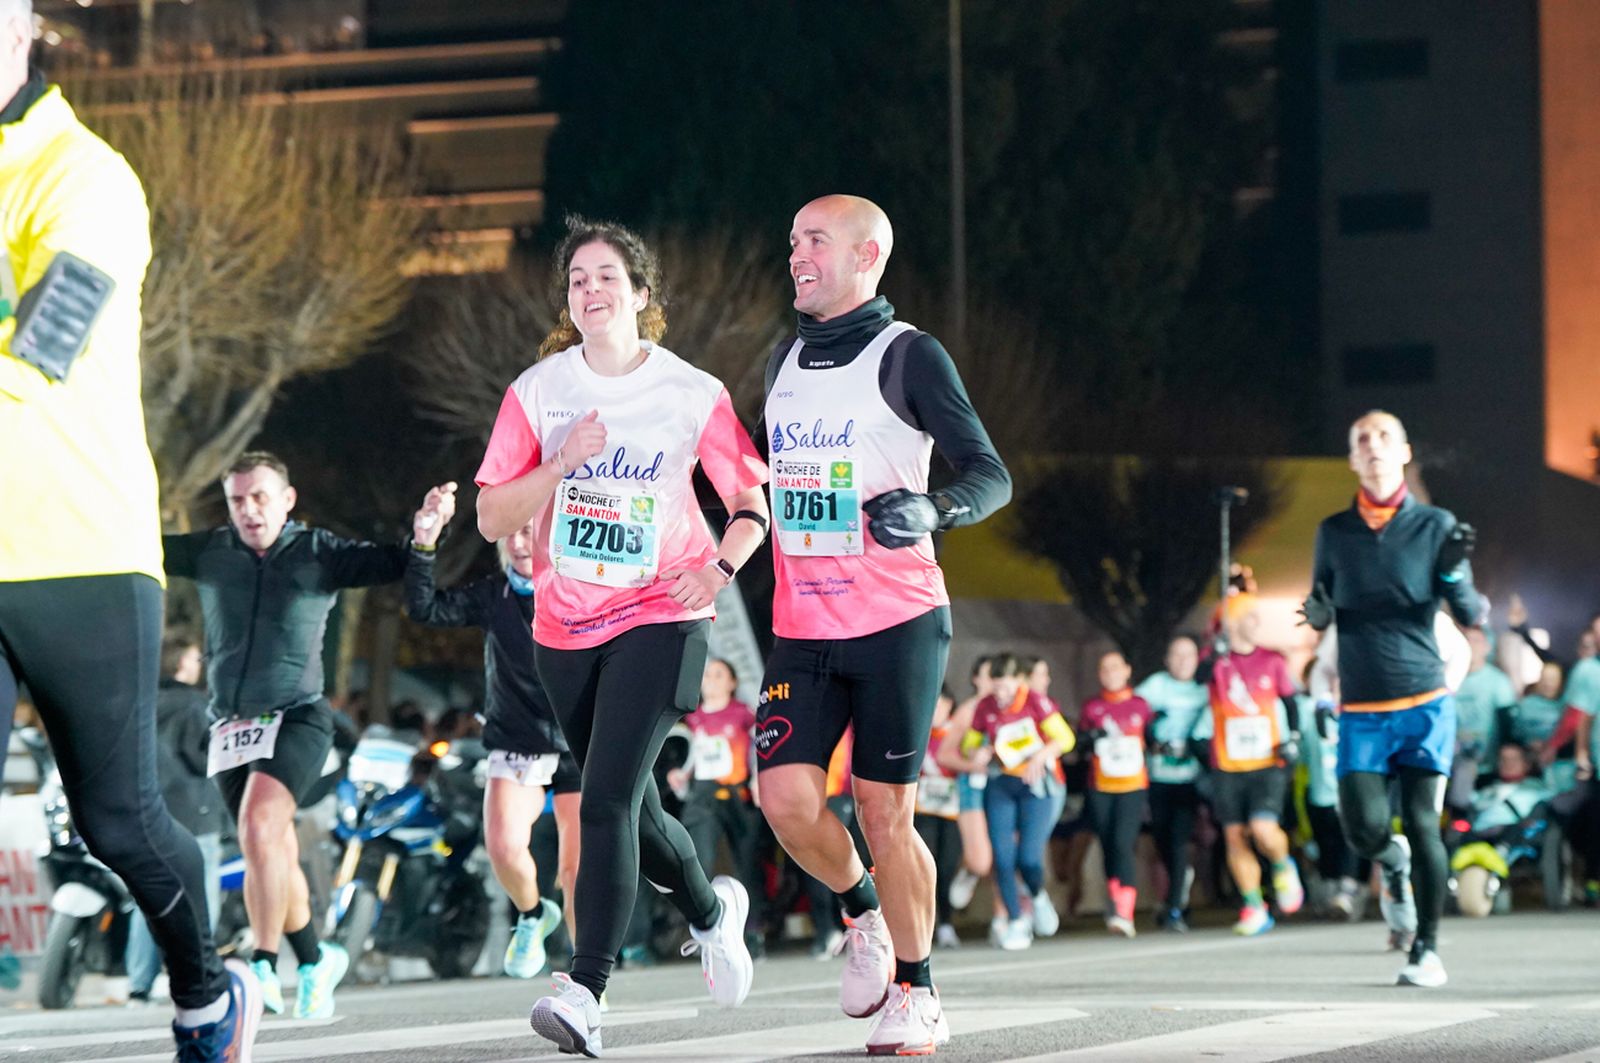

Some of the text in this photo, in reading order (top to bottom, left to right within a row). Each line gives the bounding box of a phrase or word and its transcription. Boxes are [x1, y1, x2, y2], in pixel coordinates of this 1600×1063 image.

[783, 418, 855, 451] Salud
[784, 465, 808, 475] NOCHE
[809, 465, 821, 476] DE
[776, 477, 789, 488] SAN
[579, 494, 608, 507] NOCHE
[784, 490, 838, 521] 8761
[566, 503, 586, 516] SAN
[567, 518, 645, 555] 12703
[599, 553, 624, 563] Dolores
[759, 682, 791, 704] eHi
